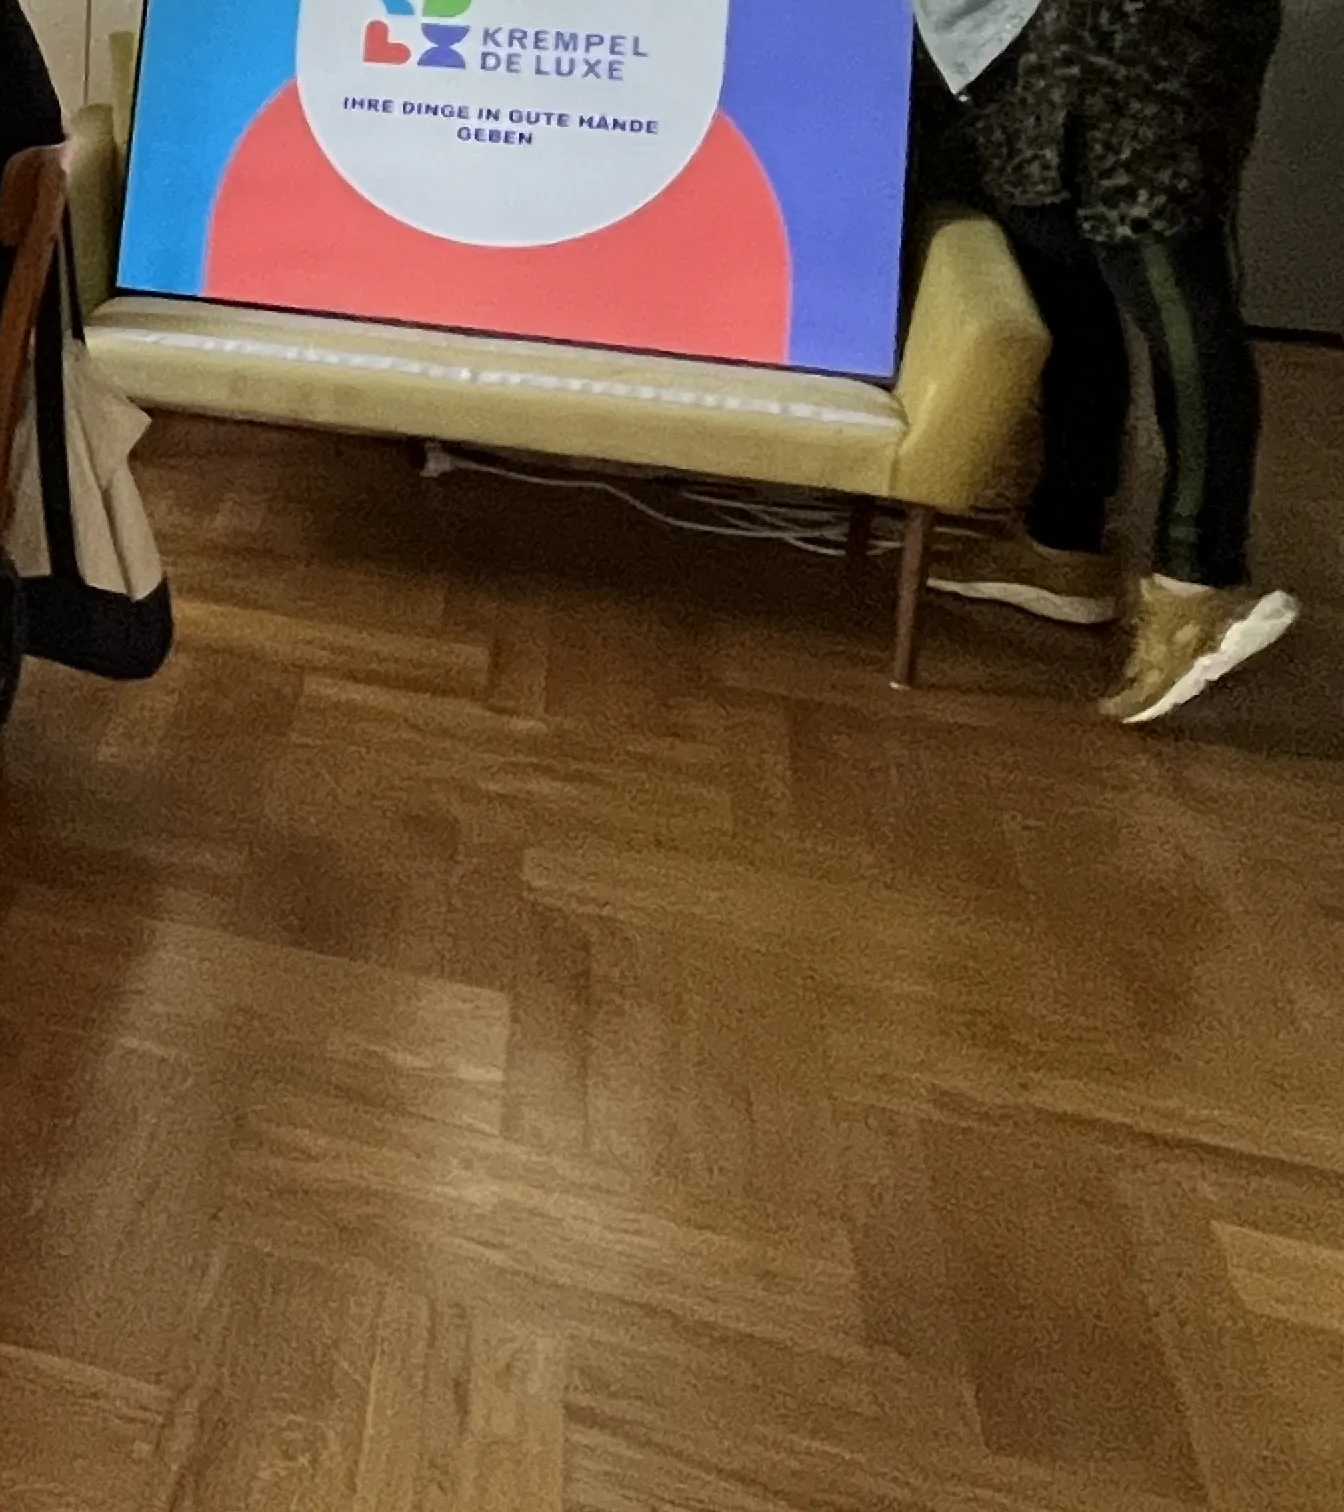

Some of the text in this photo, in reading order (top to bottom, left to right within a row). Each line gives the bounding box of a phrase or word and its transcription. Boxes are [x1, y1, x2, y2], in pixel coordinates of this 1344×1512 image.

[481, 25, 650, 58] KREMPEL
[479, 50, 626, 82] DE LUXE
[342, 96, 394, 114] IHRE
[401, 100, 470, 120] DINGE
[477, 107, 501, 122] IN
[508, 108, 570, 128] GUTE
